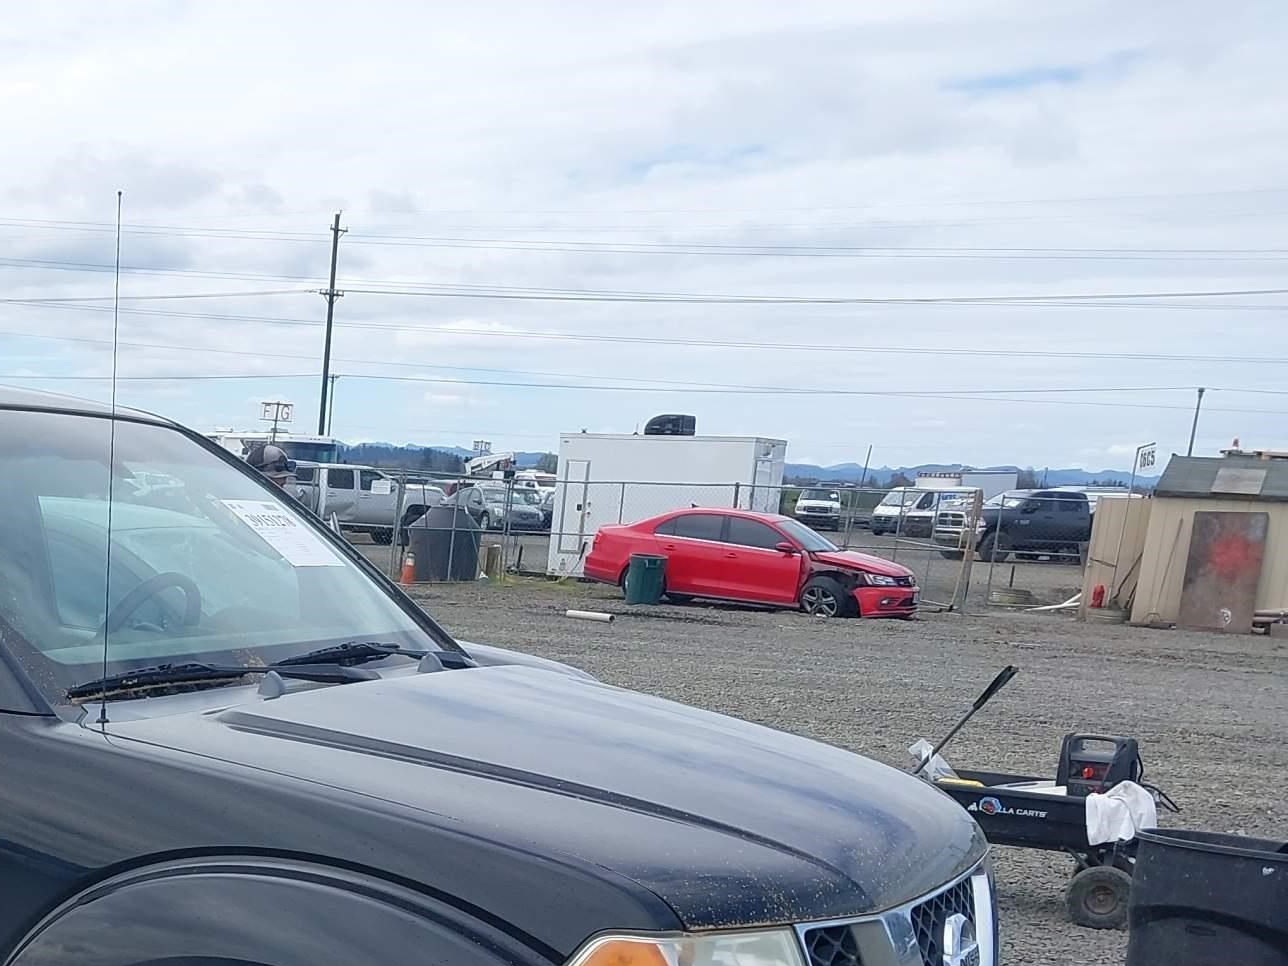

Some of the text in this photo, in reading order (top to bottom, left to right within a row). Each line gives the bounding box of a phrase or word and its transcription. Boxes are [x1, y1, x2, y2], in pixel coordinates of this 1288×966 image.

[264, 404, 290, 420] F G
[1016, 808, 1047, 818] CARTS
